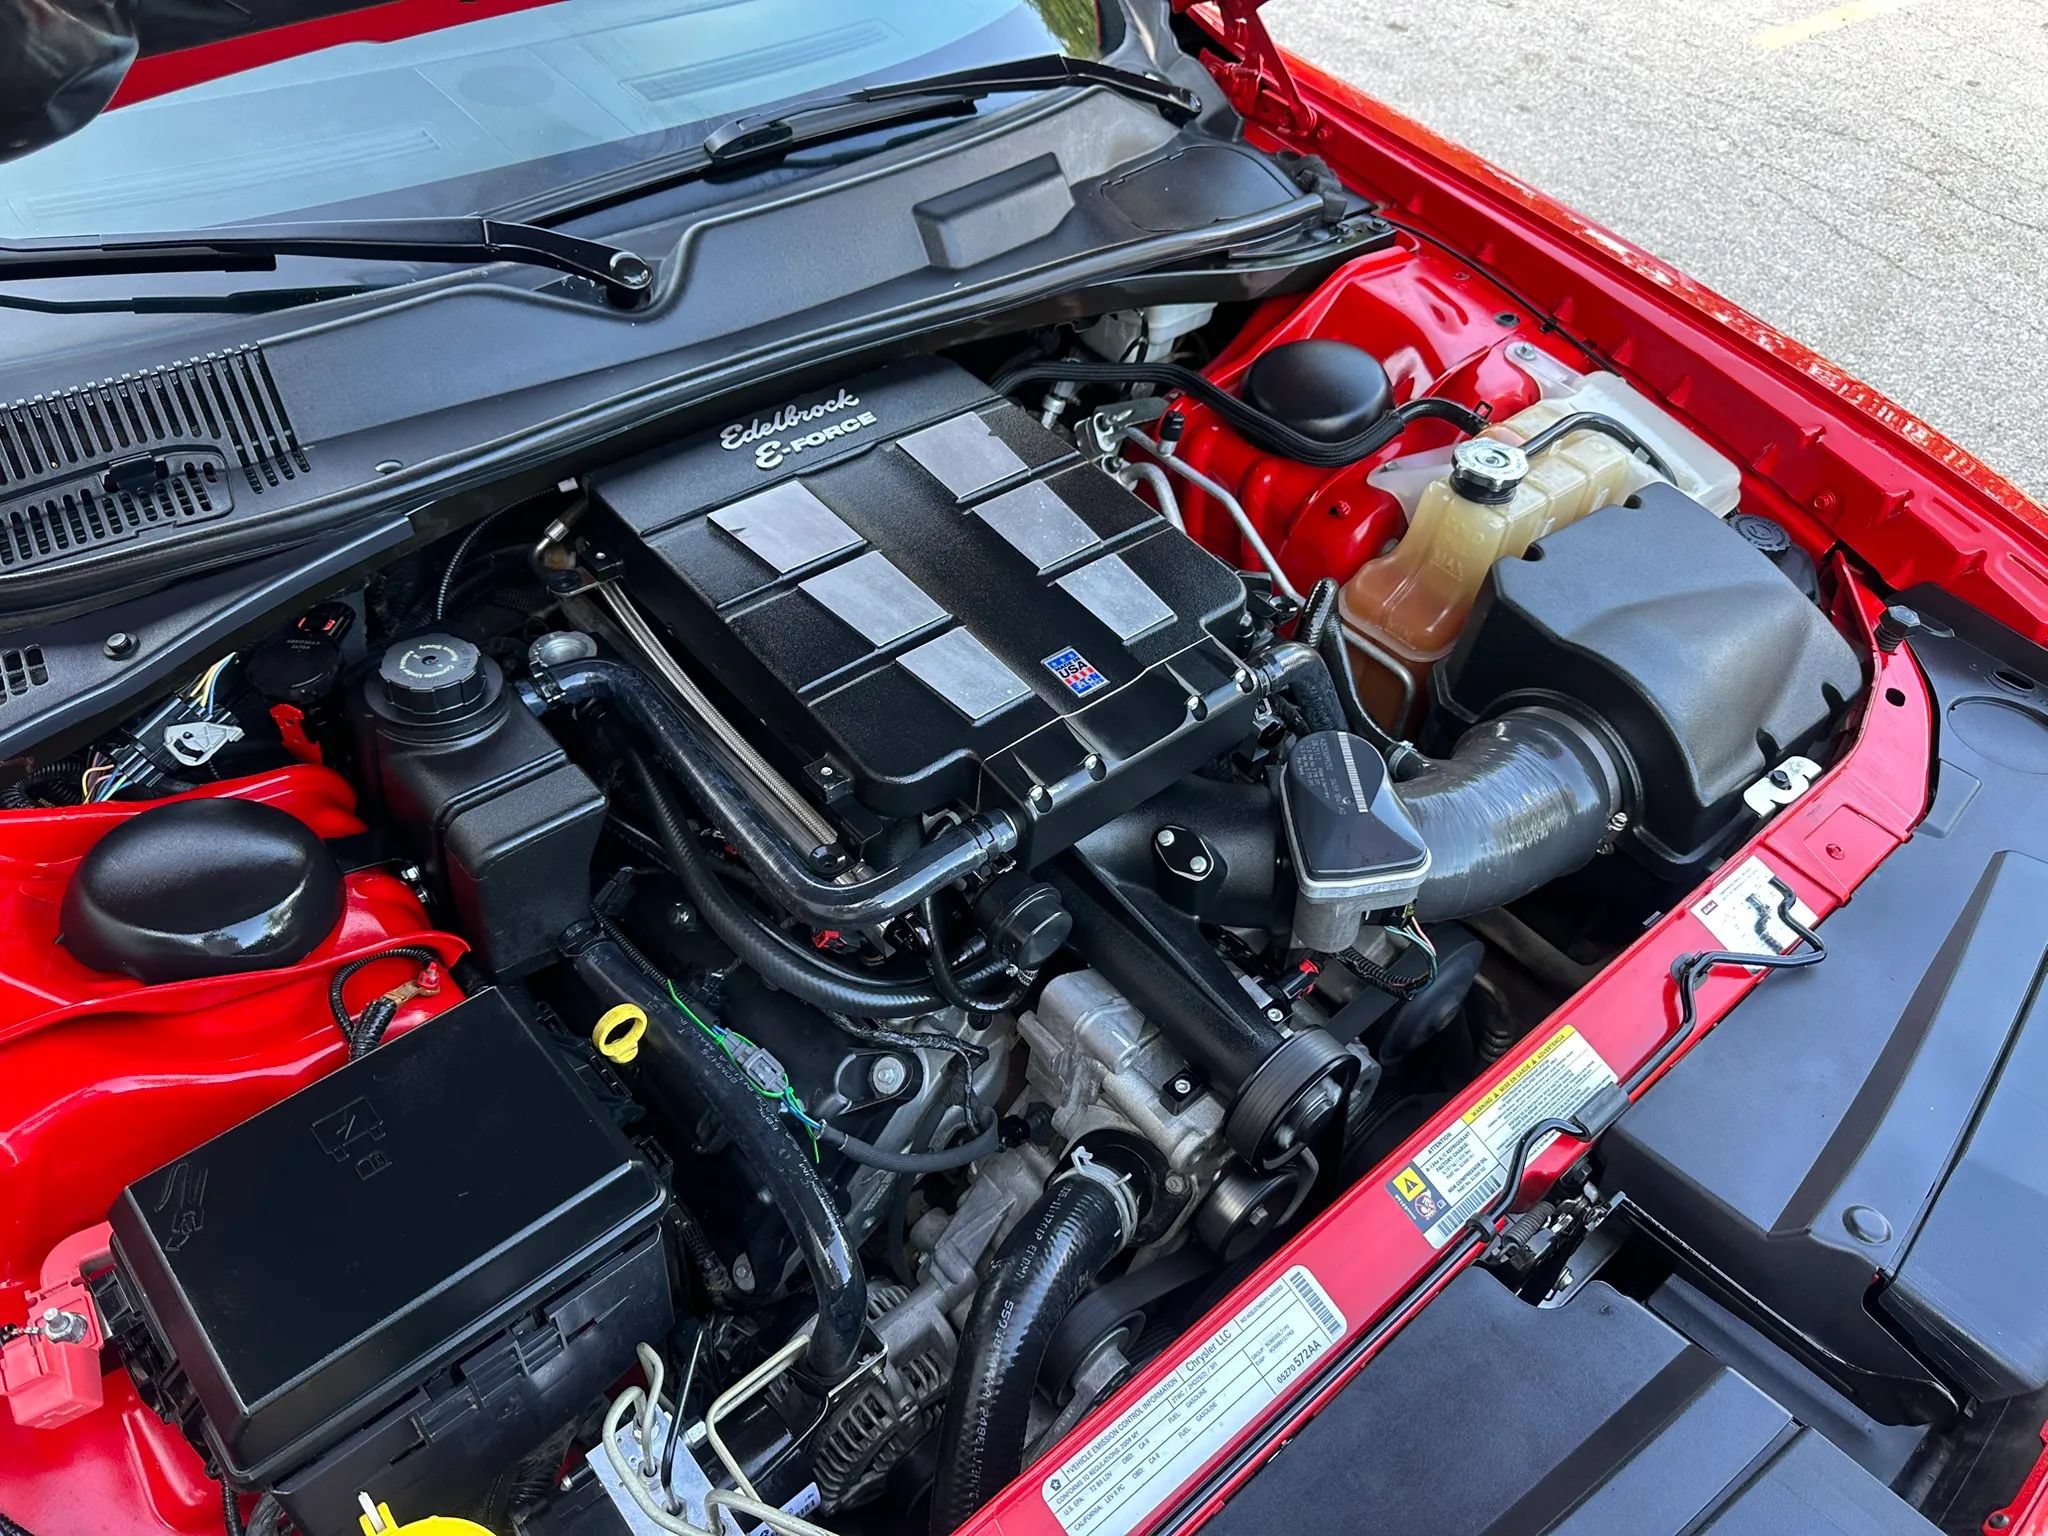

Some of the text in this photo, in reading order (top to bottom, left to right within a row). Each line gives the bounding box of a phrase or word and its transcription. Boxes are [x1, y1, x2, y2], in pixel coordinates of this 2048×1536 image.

[720, 390, 860, 451] Edelbrock
[755, 411, 878, 470] E-FORCE
[1054, 660, 1073, 671] MADE
[1058, 661, 1087, 678] USA
[1471, 1097, 1492, 1116] WARNING
[1499, 1081, 1511, 1091] MISE
[1516, 1064, 1530, 1077] GARDE
[1537, 1034, 1564, 1058] ADVERTENCIA
[1427, 1132, 1451, 1153] ATTENTION
[1436, 1156, 1452, 1171] FACTORY
[1185, 1329, 1231, 1372] Chrysler LLC
[1276, 1339, 1321, 1382] 05270 572AA
[1091, 1427, 1119, 1453] EMISSION
[1117, 1406, 1143, 1430] CONTROL
[1142, 1376, 1177, 1409] INFORMATION
[1102, 1471, 1112, 1481] LDV
[1138, 1441, 1146, 1449] CA
[1185, 1388, 1207, 1407] GASOLINE
[1056, 1479, 1083, 1504] CONFORMS
[1120, 1437, 1132, 1448] 2009
[1074, 1505, 1102, 1531] CALIFORNIA:
[1104, 1493, 1114, 1502] LEV
[1195, 1401, 1217, 1421] GASOLINE
